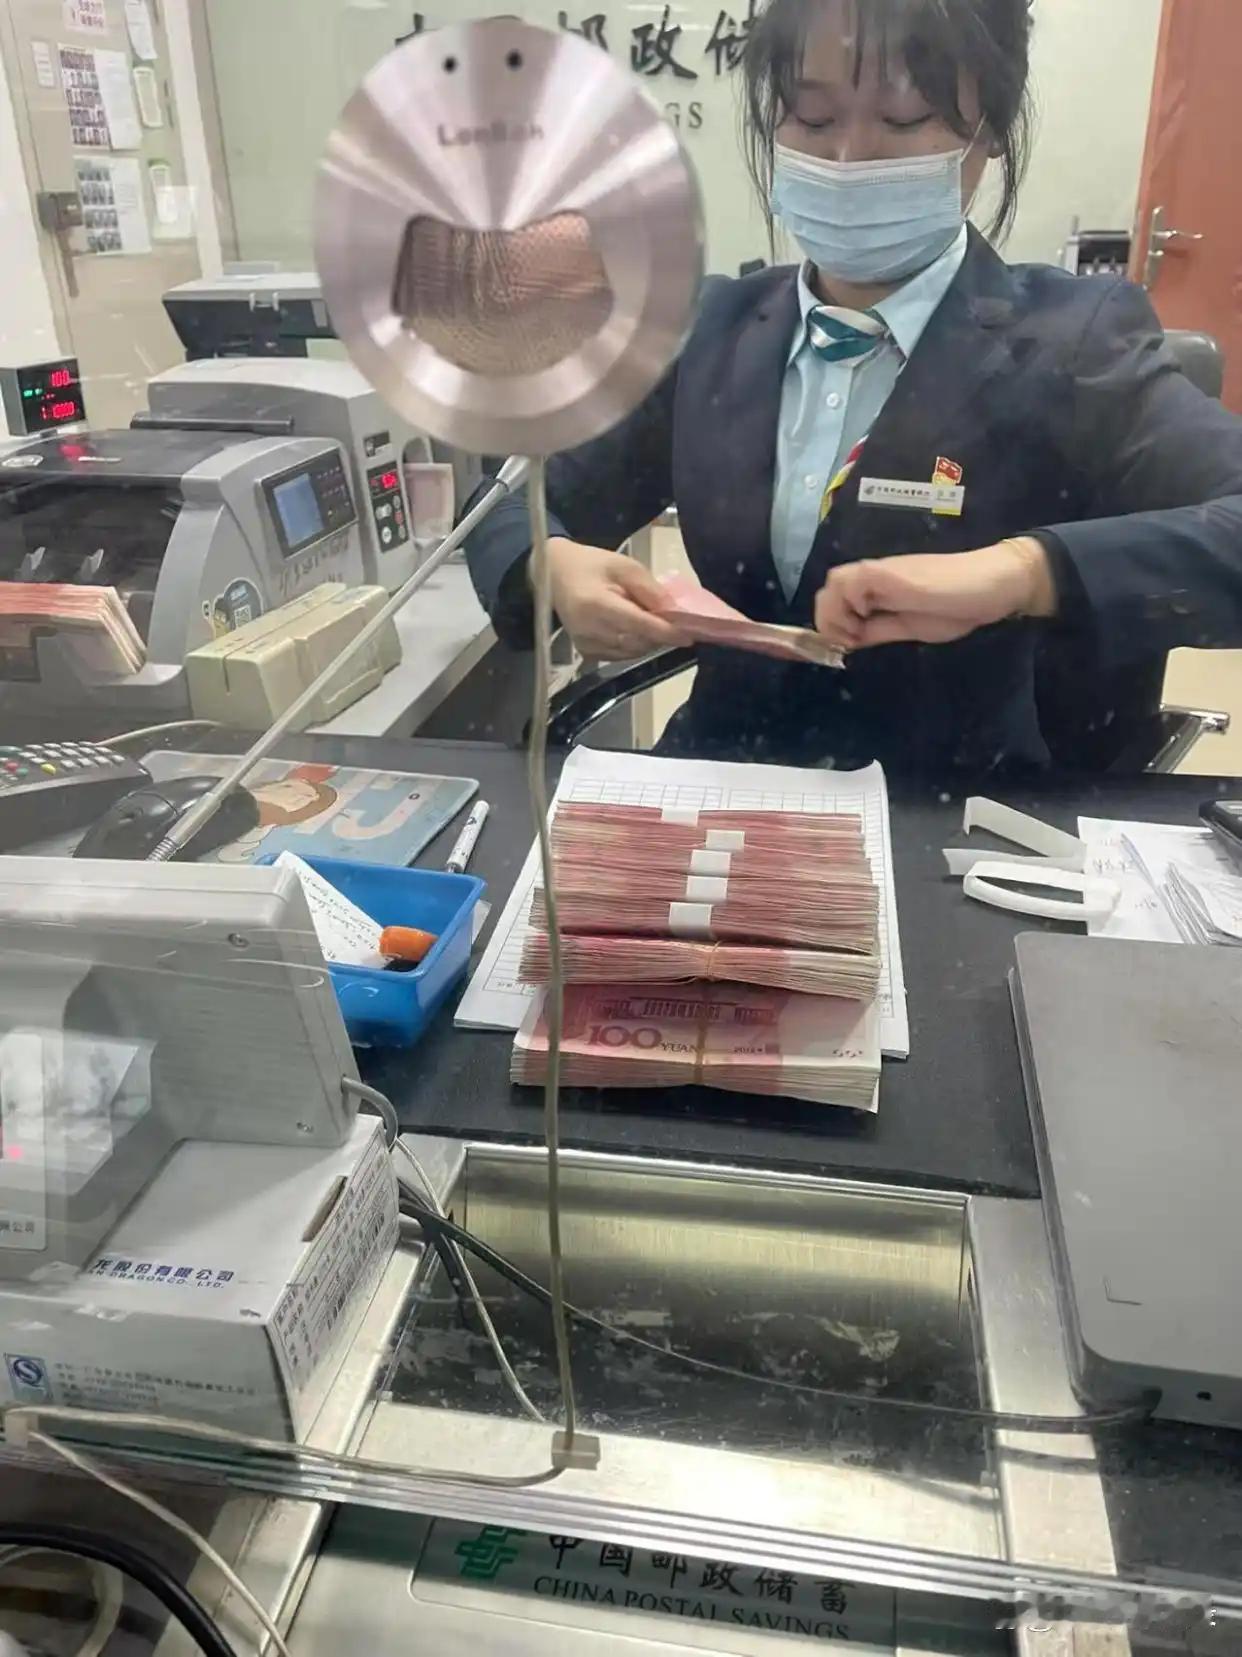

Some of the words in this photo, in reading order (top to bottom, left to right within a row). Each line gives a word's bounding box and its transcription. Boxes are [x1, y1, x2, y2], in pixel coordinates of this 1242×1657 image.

[584, 1024, 662, 1049] 100
[533, 1575, 617, 1606] CHINA
[731, 1606, 850, 1641] SAVINGS
